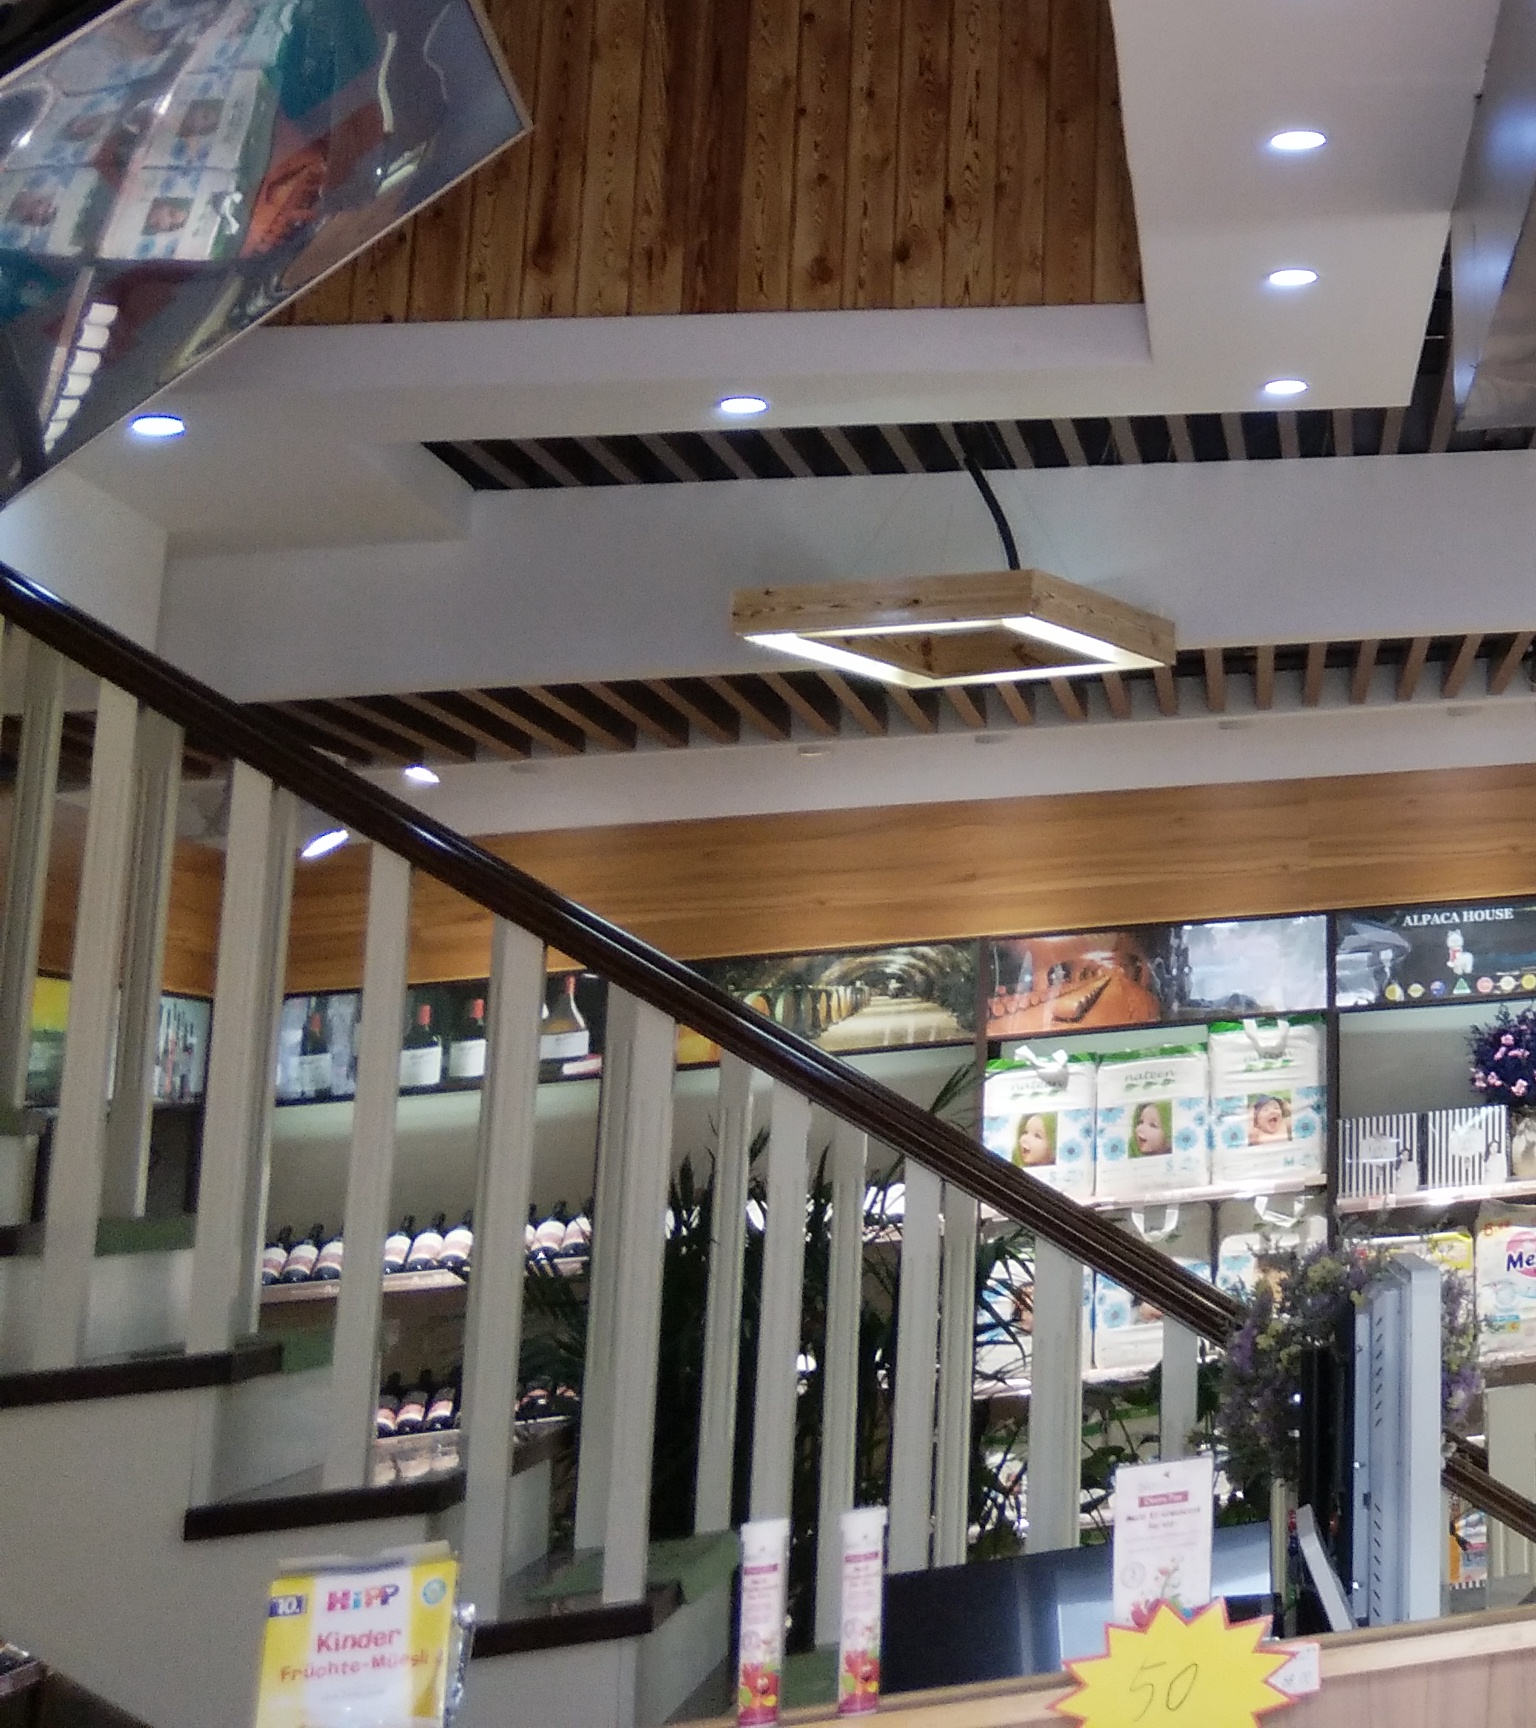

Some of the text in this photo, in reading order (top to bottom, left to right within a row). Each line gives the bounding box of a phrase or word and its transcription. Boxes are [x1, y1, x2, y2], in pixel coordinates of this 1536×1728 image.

[1402, 907, 1515, 927] ALPACA HOUSE
[316, 1628, 402, 1654] Kinder
[1129, 1661, 1199, 1723] 50
